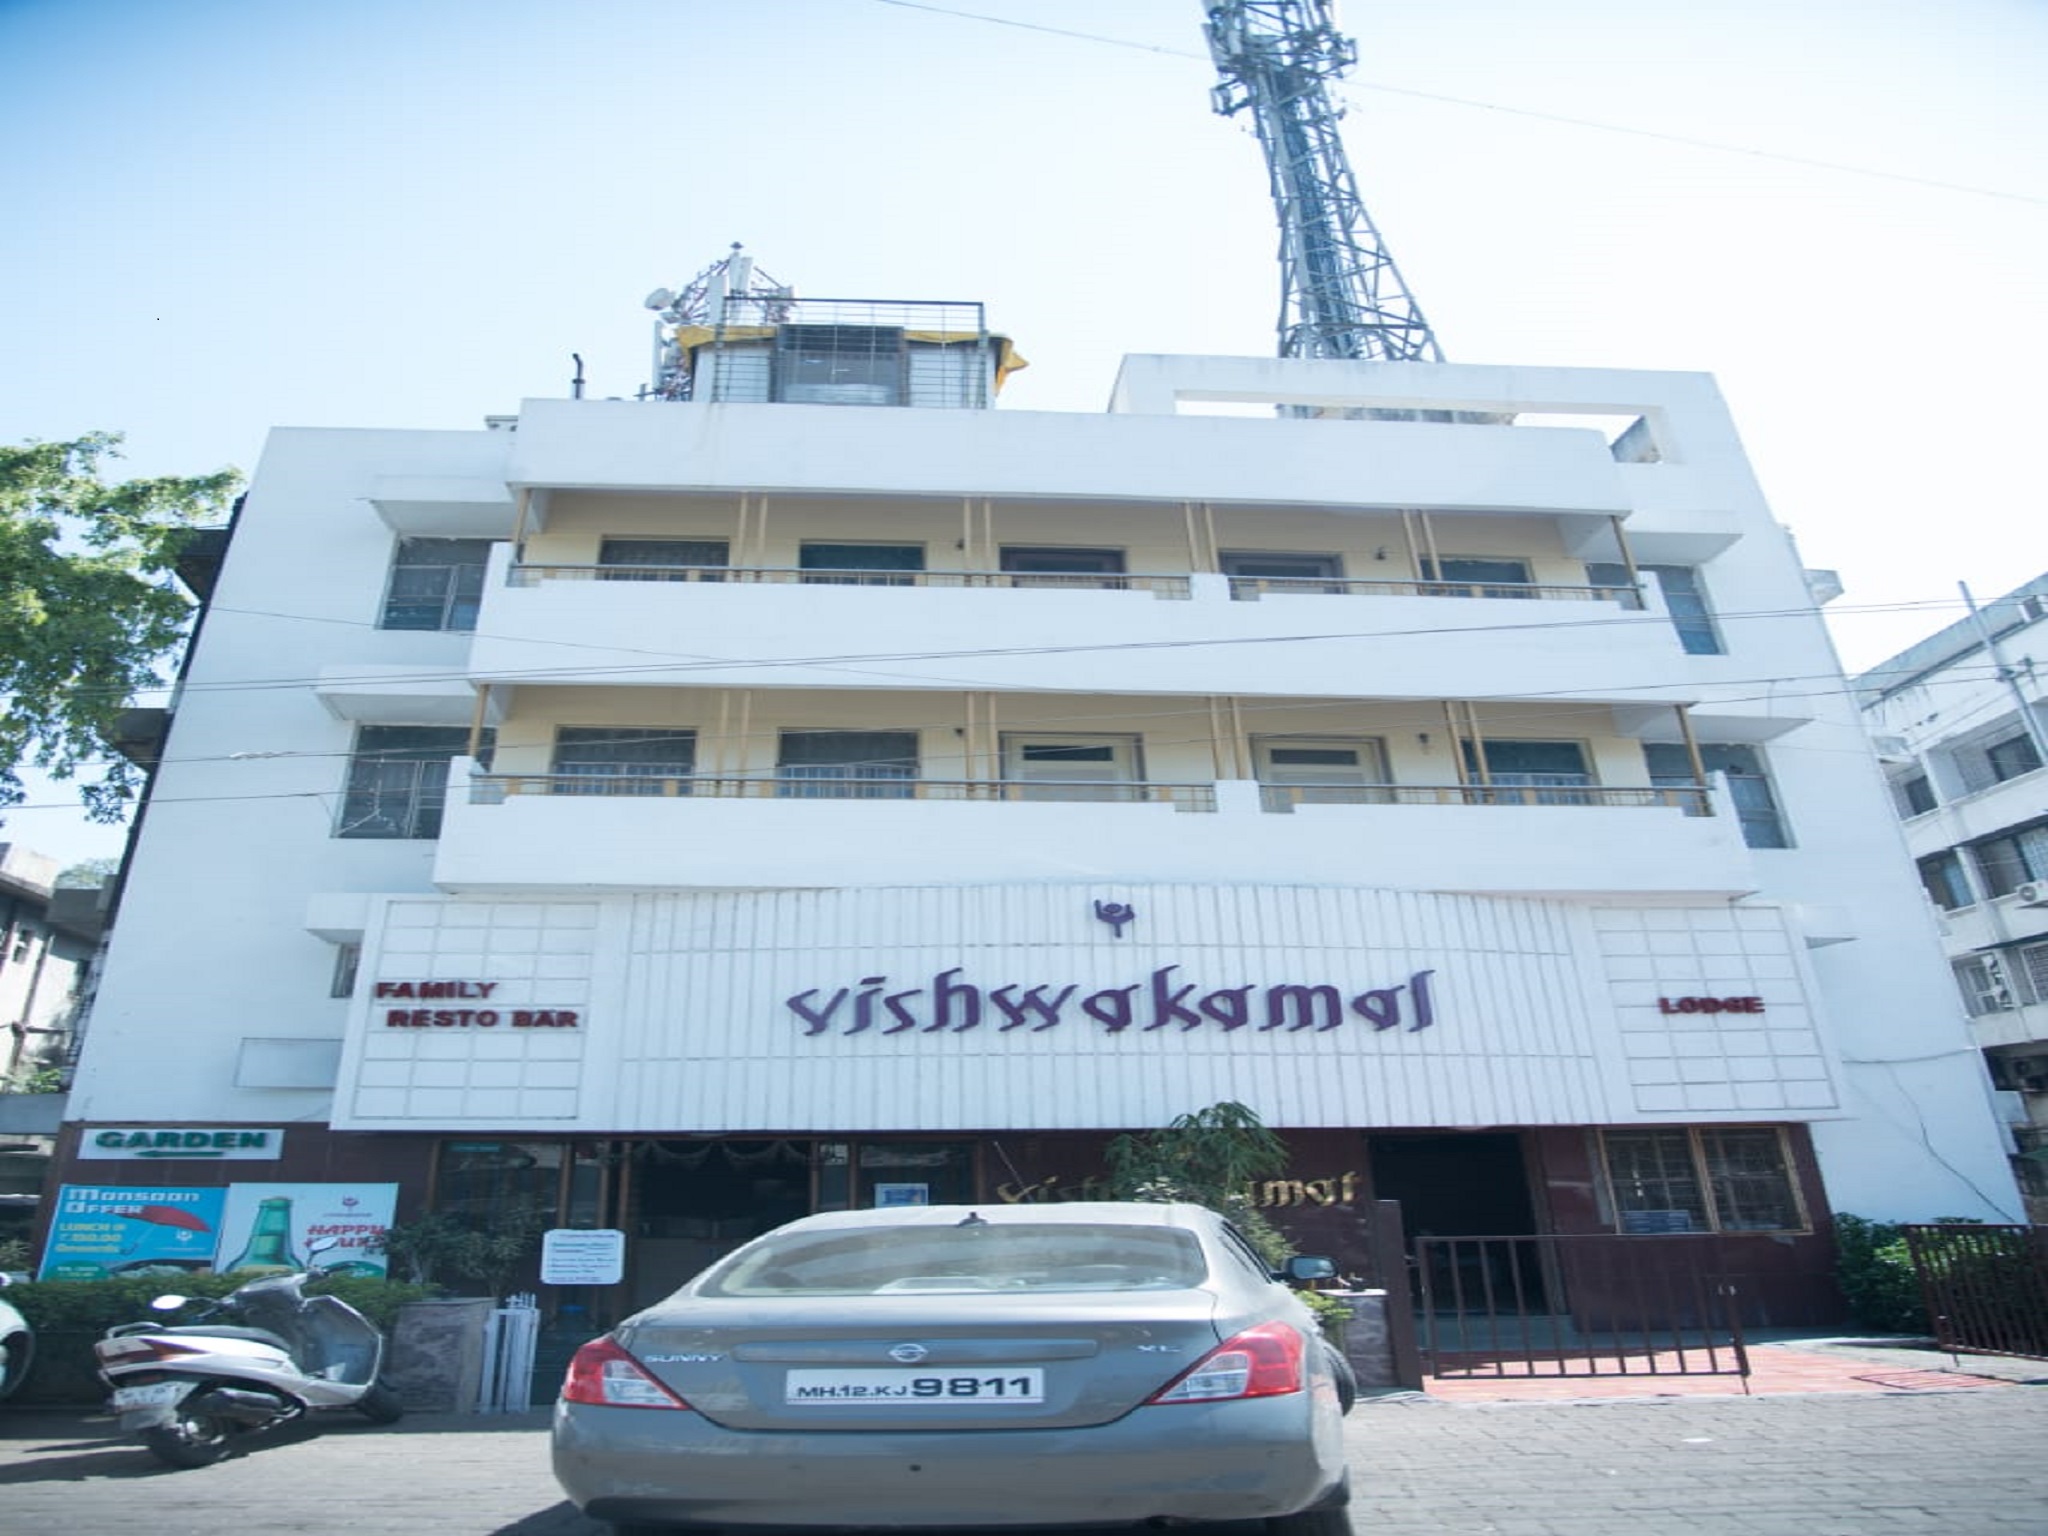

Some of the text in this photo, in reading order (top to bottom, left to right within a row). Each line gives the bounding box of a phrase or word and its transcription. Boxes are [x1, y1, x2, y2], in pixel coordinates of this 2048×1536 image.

[376, 982, 498, 999] FAMILY
[1659, 996, 1765, 1014] LODGE
[387, 1009, 578, 1027] RESTO BAR
[95, 1131, 268, 1149] GARDEN
[644, 1353, 724, 1363] SUNNY
[912, 1377, 1031, 1397] 9811
